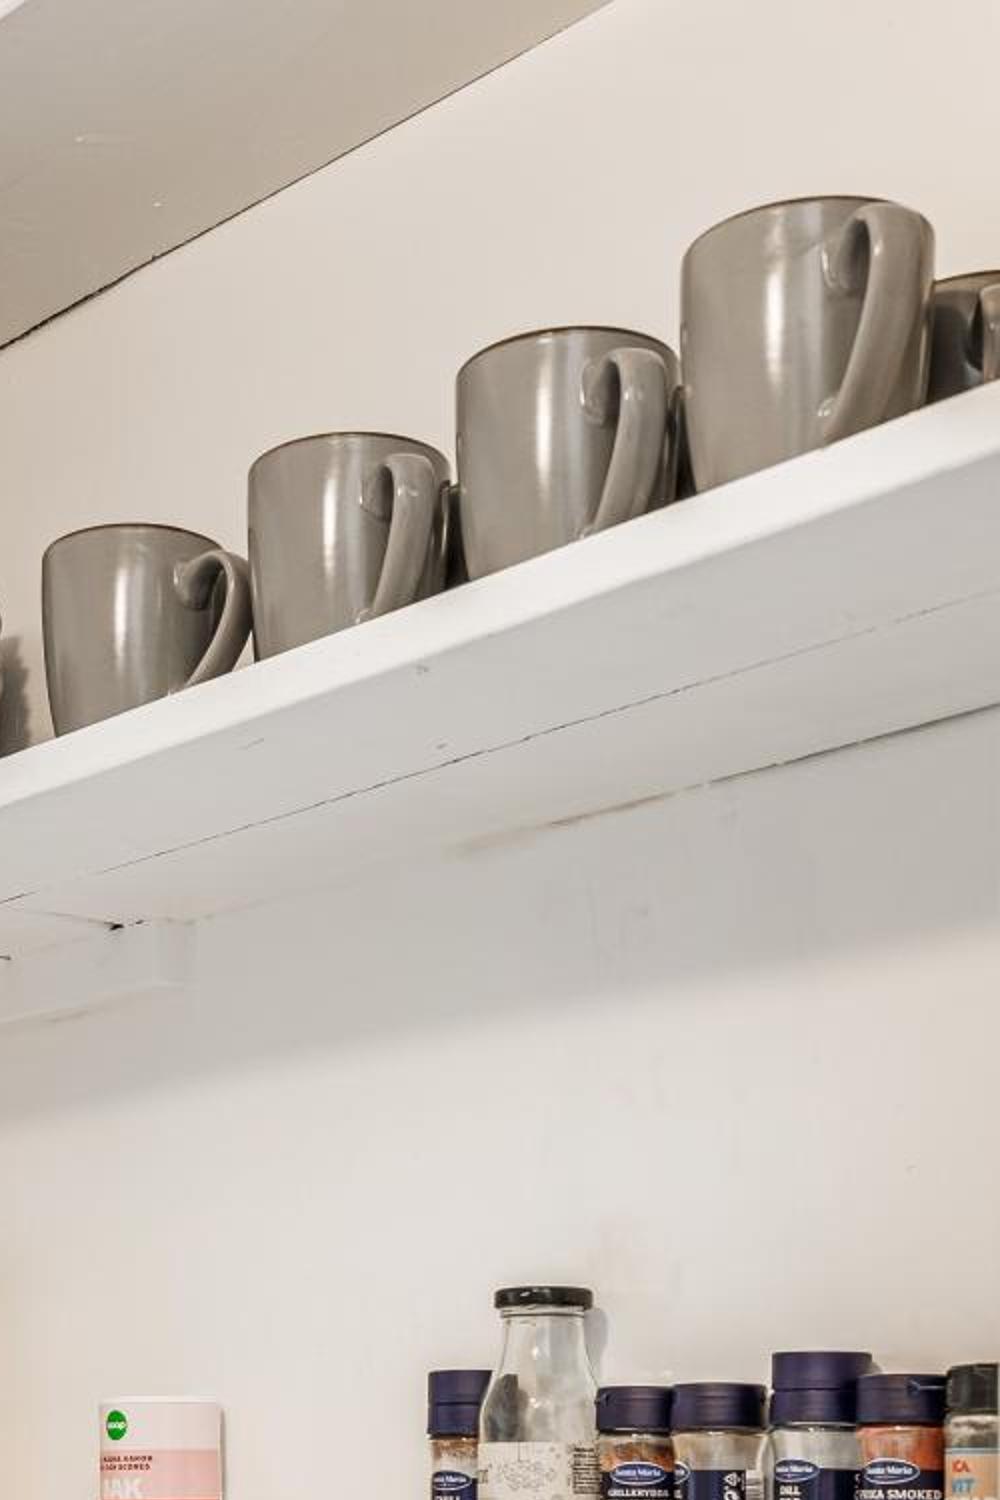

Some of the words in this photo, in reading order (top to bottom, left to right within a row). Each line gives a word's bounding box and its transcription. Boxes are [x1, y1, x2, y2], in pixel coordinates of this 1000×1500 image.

[638, 1467, 661, 1477] Maria
[887, 1465, 914, 1475] Maria
[779, 1485, 802, 1495] DILL
[886, 1489, 943, 1500] SMOKED
